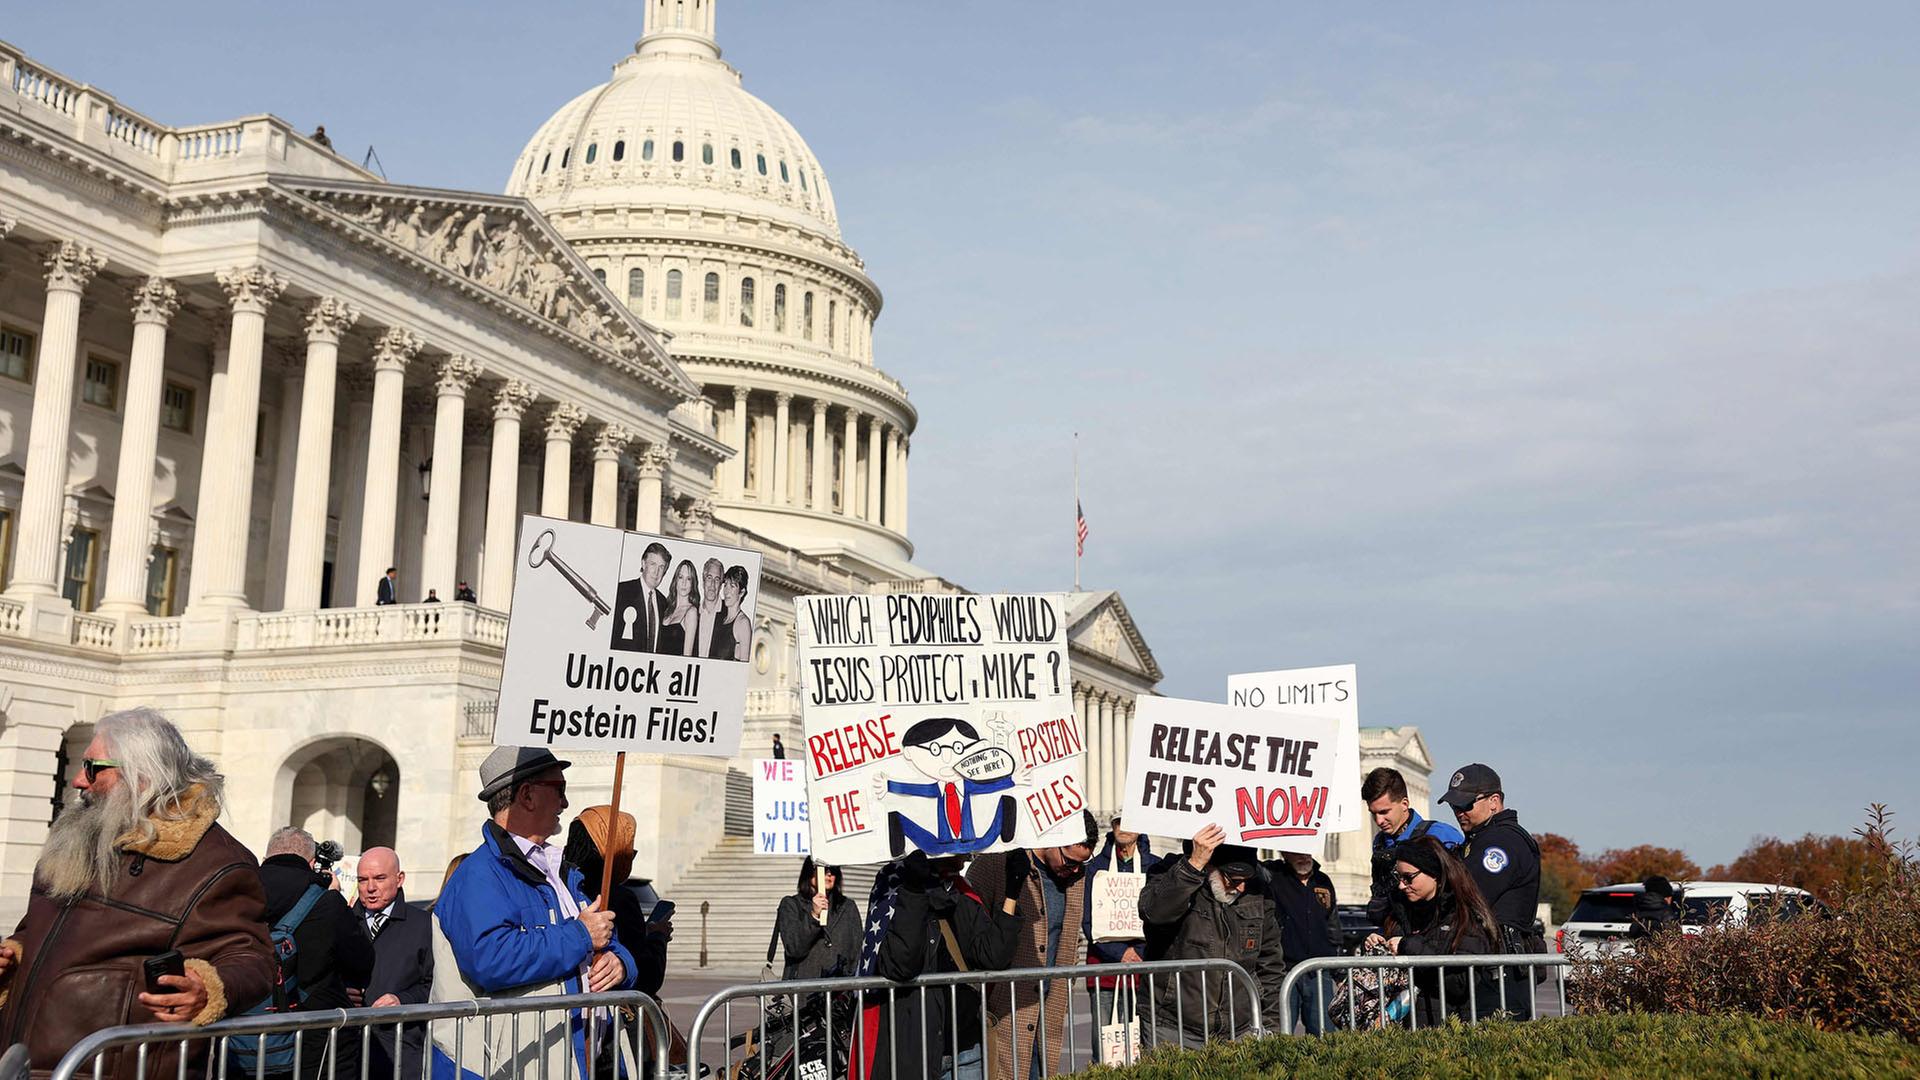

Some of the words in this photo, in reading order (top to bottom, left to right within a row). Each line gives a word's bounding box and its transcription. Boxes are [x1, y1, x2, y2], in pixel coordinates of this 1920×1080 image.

[808, 596, 873, 645] WHICH
[887, 594, 981, 644] PEDOPHILES
[991, 596, 1057, 642] WOULD
[566, 653, 660, 694] Unlock
[668, 664, 701, 697] all
[810, 657, 874, 705] JESUS
[1234, 686, 1265, 707] NO
[1278, 680, 1349, 705] LIMITS
[530, 699, 637, 744] Epstein
[646, 706, 718, 743] Files!
[1017, 714, 1082, 769] EPSTEIN
[808, 714, 900, 777] RELEASE
[961, 753, 987, 768] NOTHING
[990, 750, 1000, 758] TO
[1149, 723, 1260, 772] RELEASE
[1266, 736, 1318, 778] THE
[763, 761, 793, 781] WE
[967, 767, 979, 777] SEE
[766, 800, 809, 821] JUS
[823, 789, 865, 835] THE
[1026, 774, 1083, 832] FILES
[1142, 771, 1216, 814] FILES
[1235, 785, 1328, 827] NOW!
[762, 832, 808, 853] WIL
[1105, 888, 1138, 898] WOUL
[1106, 877, 1144, 888] WHAT
[1110, 910, 1138, 920] HAVE
